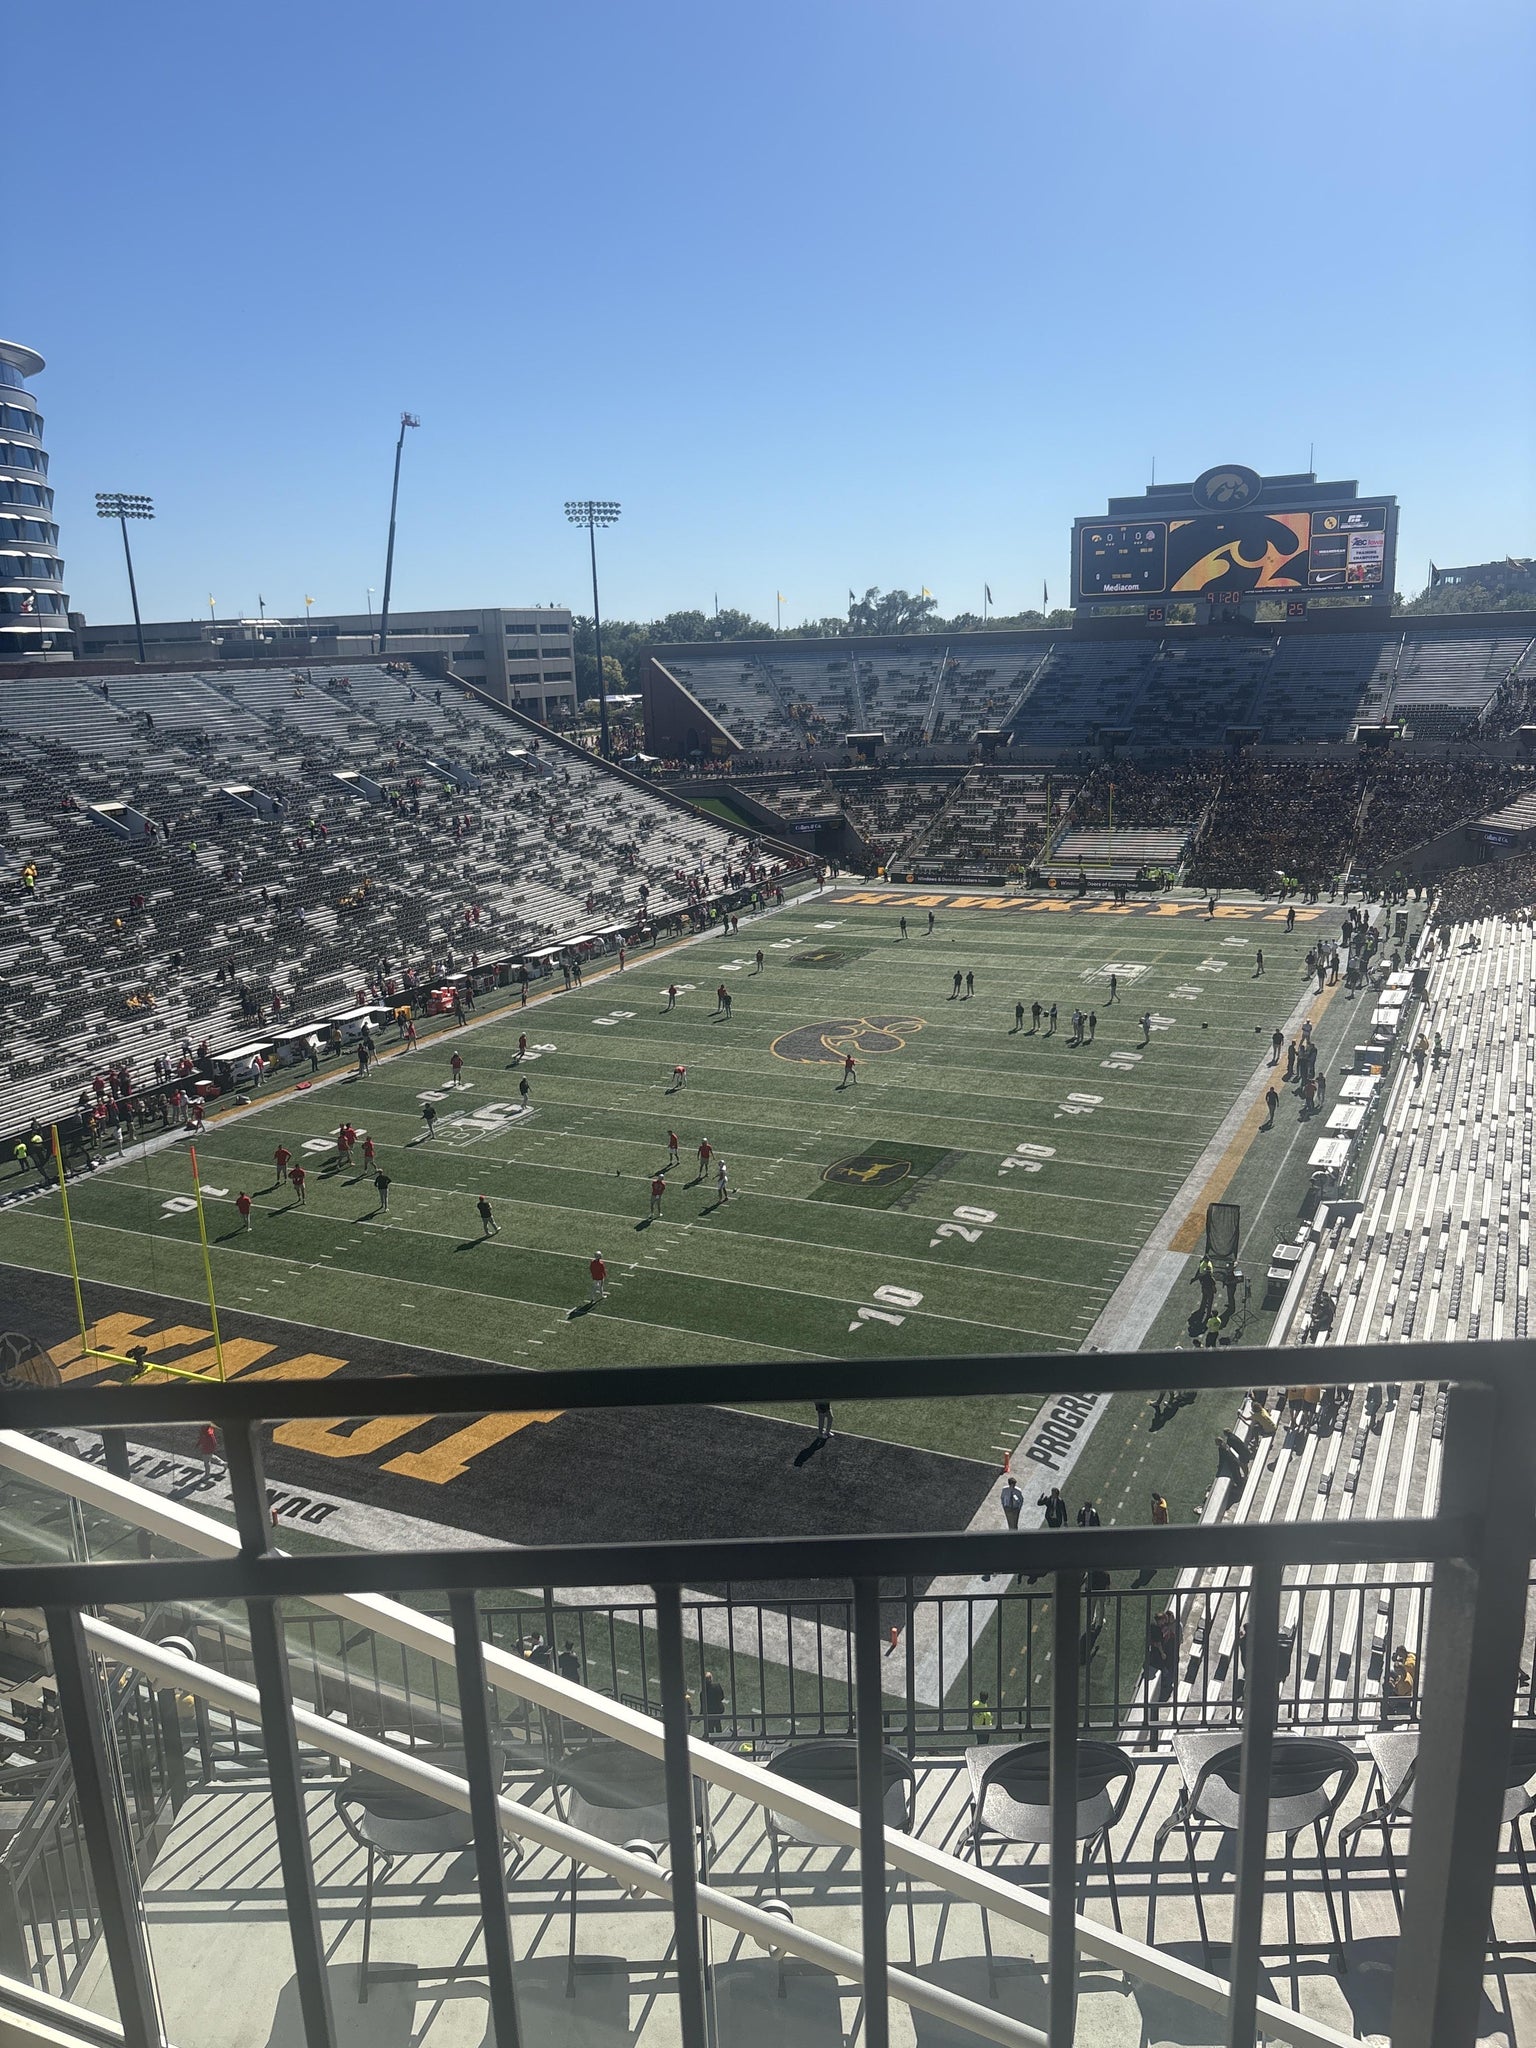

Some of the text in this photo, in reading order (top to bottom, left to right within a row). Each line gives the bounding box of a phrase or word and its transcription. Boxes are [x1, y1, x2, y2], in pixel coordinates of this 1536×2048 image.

[1103, 583, 1139, 592] Mediacom
[1149, 608, 1163, 620] 25
[1288, 603, 1303, 615] 25
[831, 892, 1328, 921] HAWKEYES
[1219, 937, 1249, 947] 10
[1195, 959, 1228, 973] 20
[1166, 985, 1204, 1000] 30
[591, 1010, 638, 1026] 50
[1099, 1050, 1144, 1071] 50
[1057, 1091, 1105, 1115] 40
[999, 1141, 1057, 1173] 30
[934, 1204, 999, 1244] 20
[856, 1283, 924, 1328] 10
